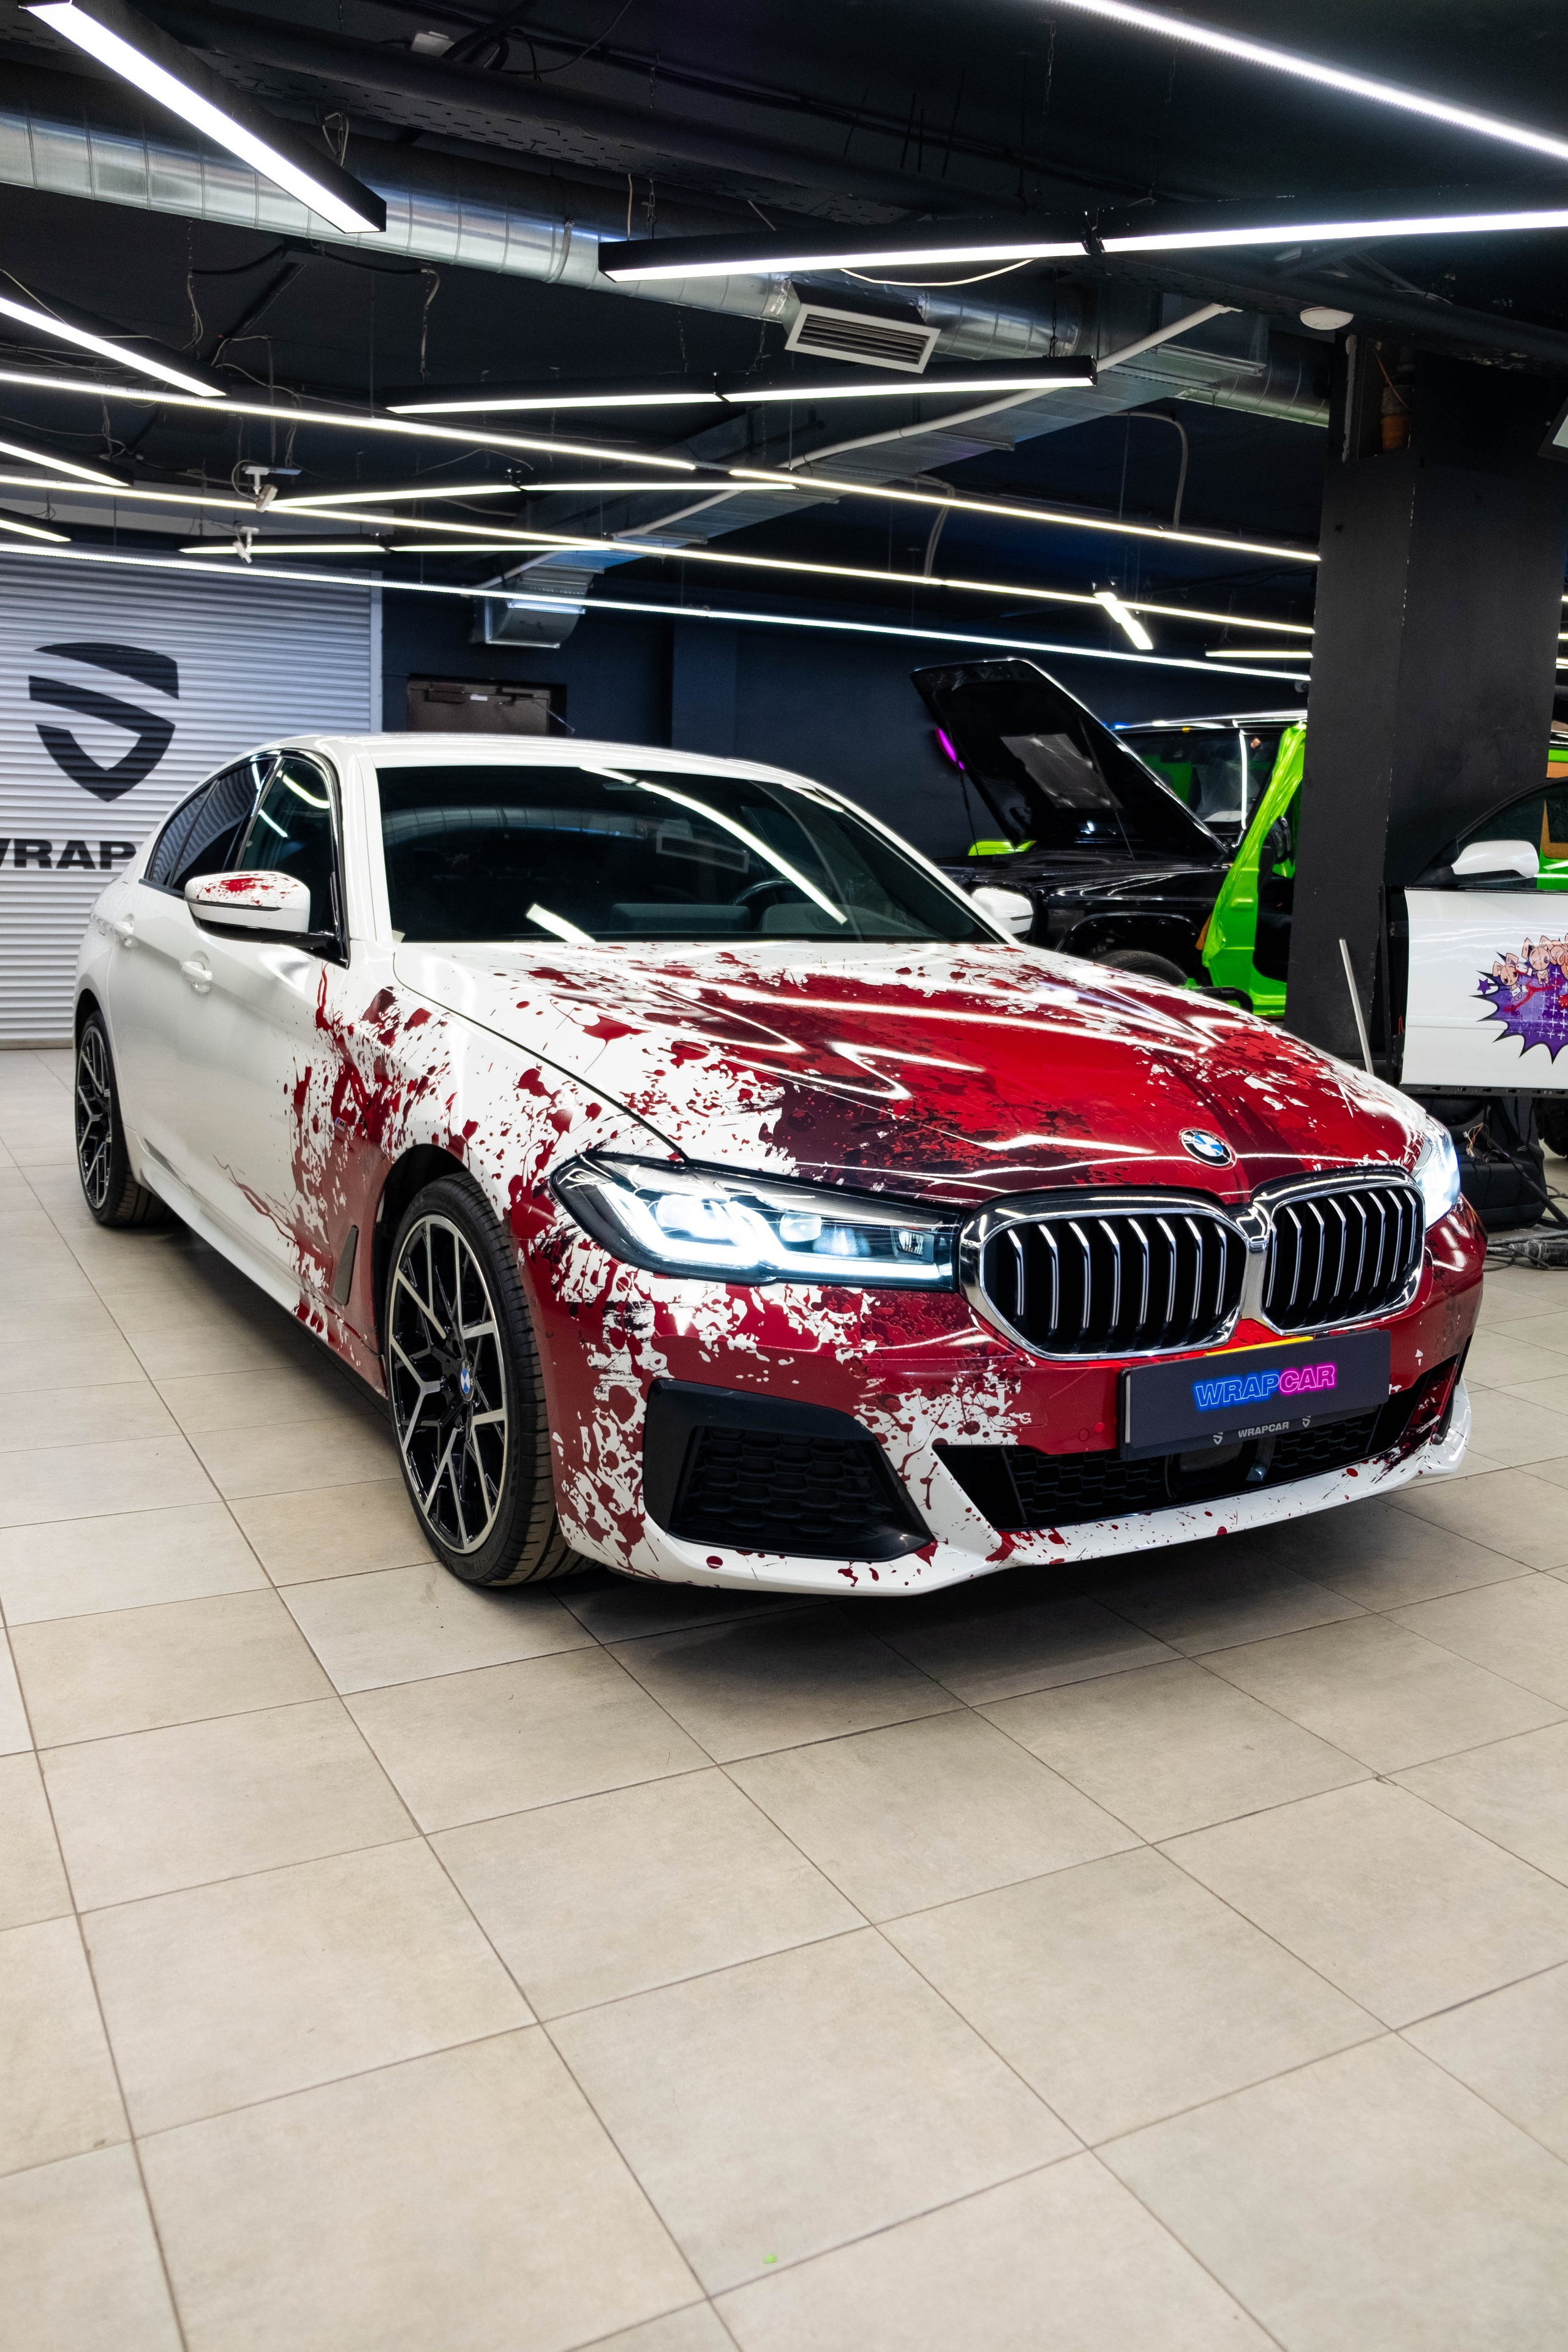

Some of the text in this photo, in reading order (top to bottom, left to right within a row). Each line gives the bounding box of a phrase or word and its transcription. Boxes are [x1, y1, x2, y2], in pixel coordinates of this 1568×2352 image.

[0, 838, 137, 870] RAP
[1195, 1365, 1335, 1407] WRAPCAR
[1238, 1421, 1289, 1438] WRAPCAR
